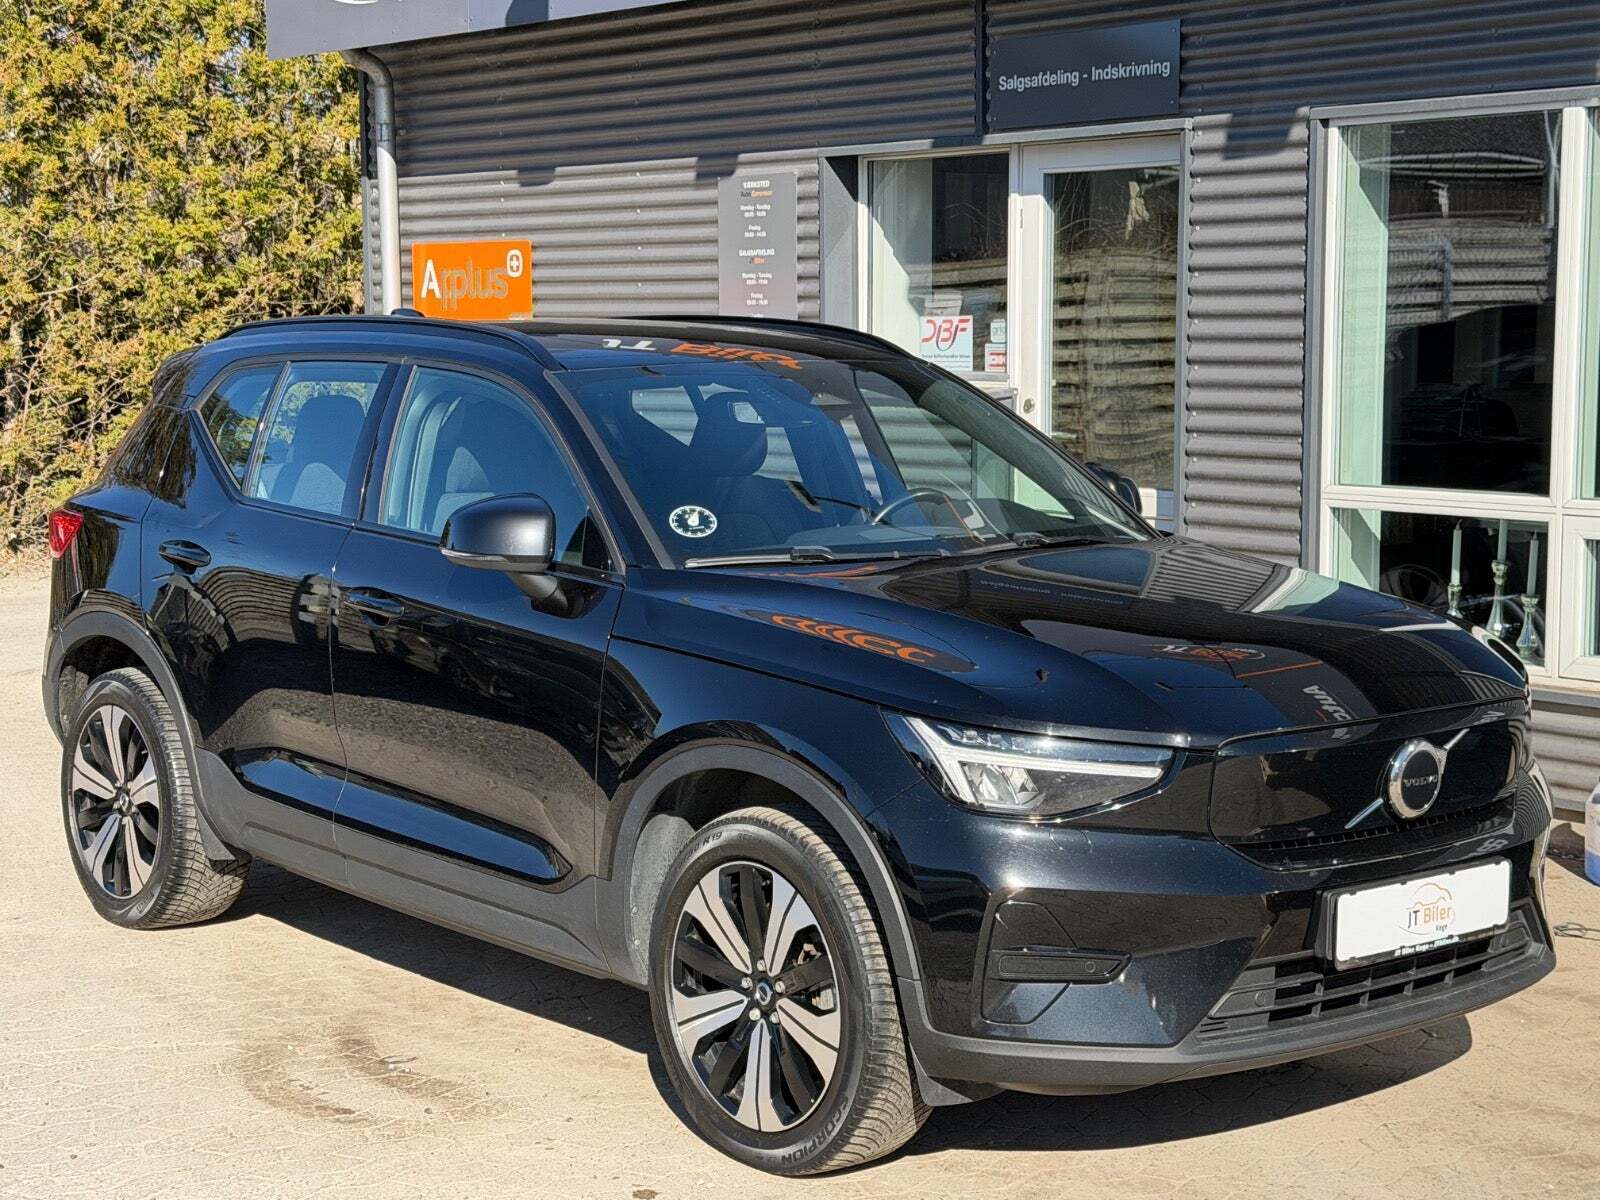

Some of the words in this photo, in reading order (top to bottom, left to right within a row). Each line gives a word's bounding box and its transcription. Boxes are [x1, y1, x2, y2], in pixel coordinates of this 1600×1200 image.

[998, 69, 1080, 92] Salgsafdeling
[1091, 59, 1171, 81] Indskrivning
[1403, 775, 1438, 787] VOLVO
[1407, 909, 1421, 929] JT
[1423, 905, 1452, 924] Biler
